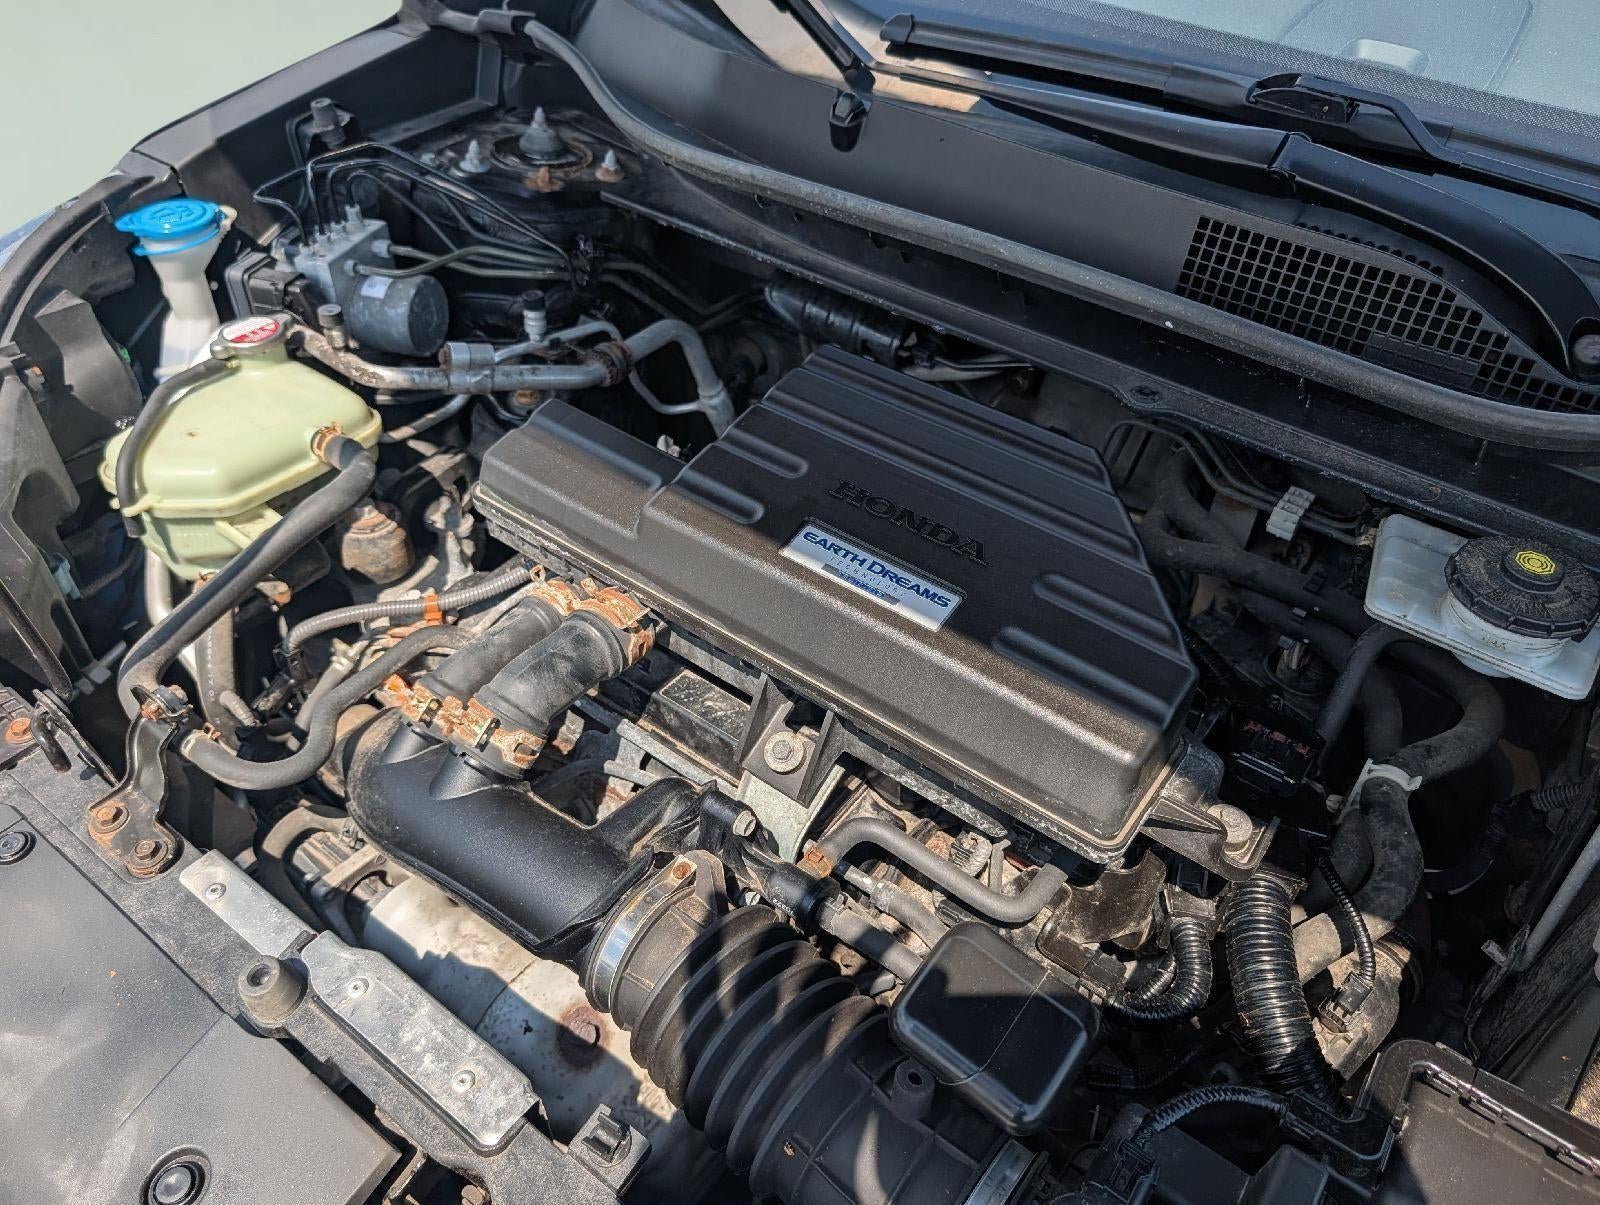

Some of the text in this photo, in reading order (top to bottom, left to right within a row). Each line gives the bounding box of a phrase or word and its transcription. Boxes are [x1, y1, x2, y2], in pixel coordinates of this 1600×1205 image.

[827, 479, 988, 566] HONDA
[803, 531, 867, 567] EARTH
[866, 560, 951, 608] DREAMS
[829, 556, 907, 597] TECHNOLOGY
